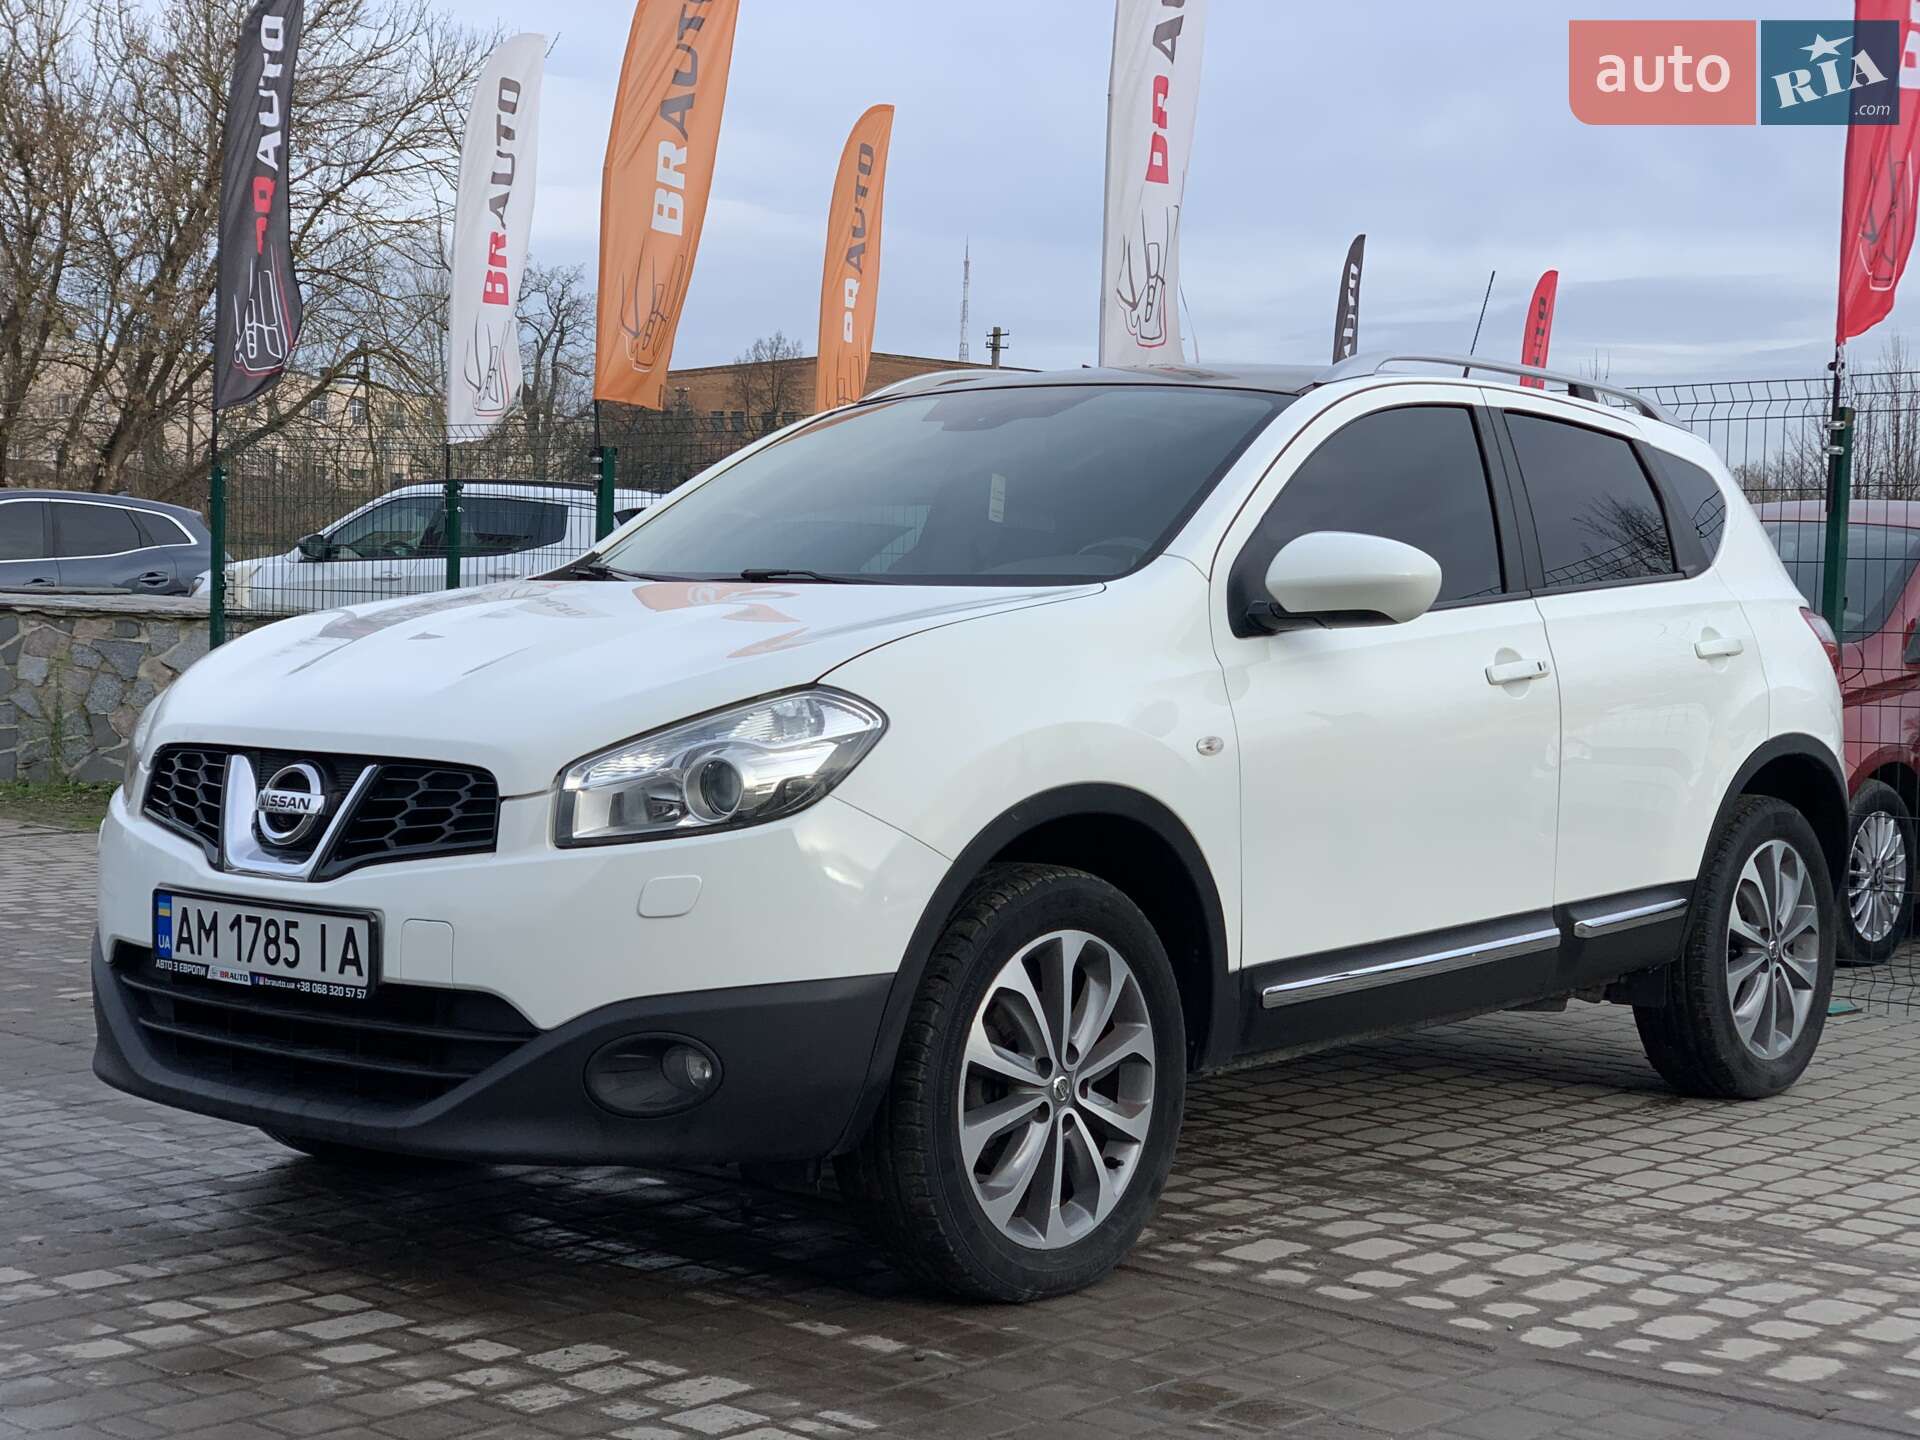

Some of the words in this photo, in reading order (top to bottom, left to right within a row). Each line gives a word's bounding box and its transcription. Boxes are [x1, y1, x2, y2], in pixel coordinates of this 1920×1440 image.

[651, 0, 713, 236] BRAUT
[482, 77, 521, 306] BRAUTO
[258, 794, 312, 811] NISSAN
[158, 934, 171, 950] UA
[175, 906, 218, 959] AM
[229, 913, 300, 969] 1785
[321, 923, 363, 977] IA
[219, 970, 249, 982] BRAUTO
[312, 983, 327, 994] 068
[329, 985, 344, 997] 320
[345, 987, 355, 998] 57
[357, 989, 367, 999] 57
